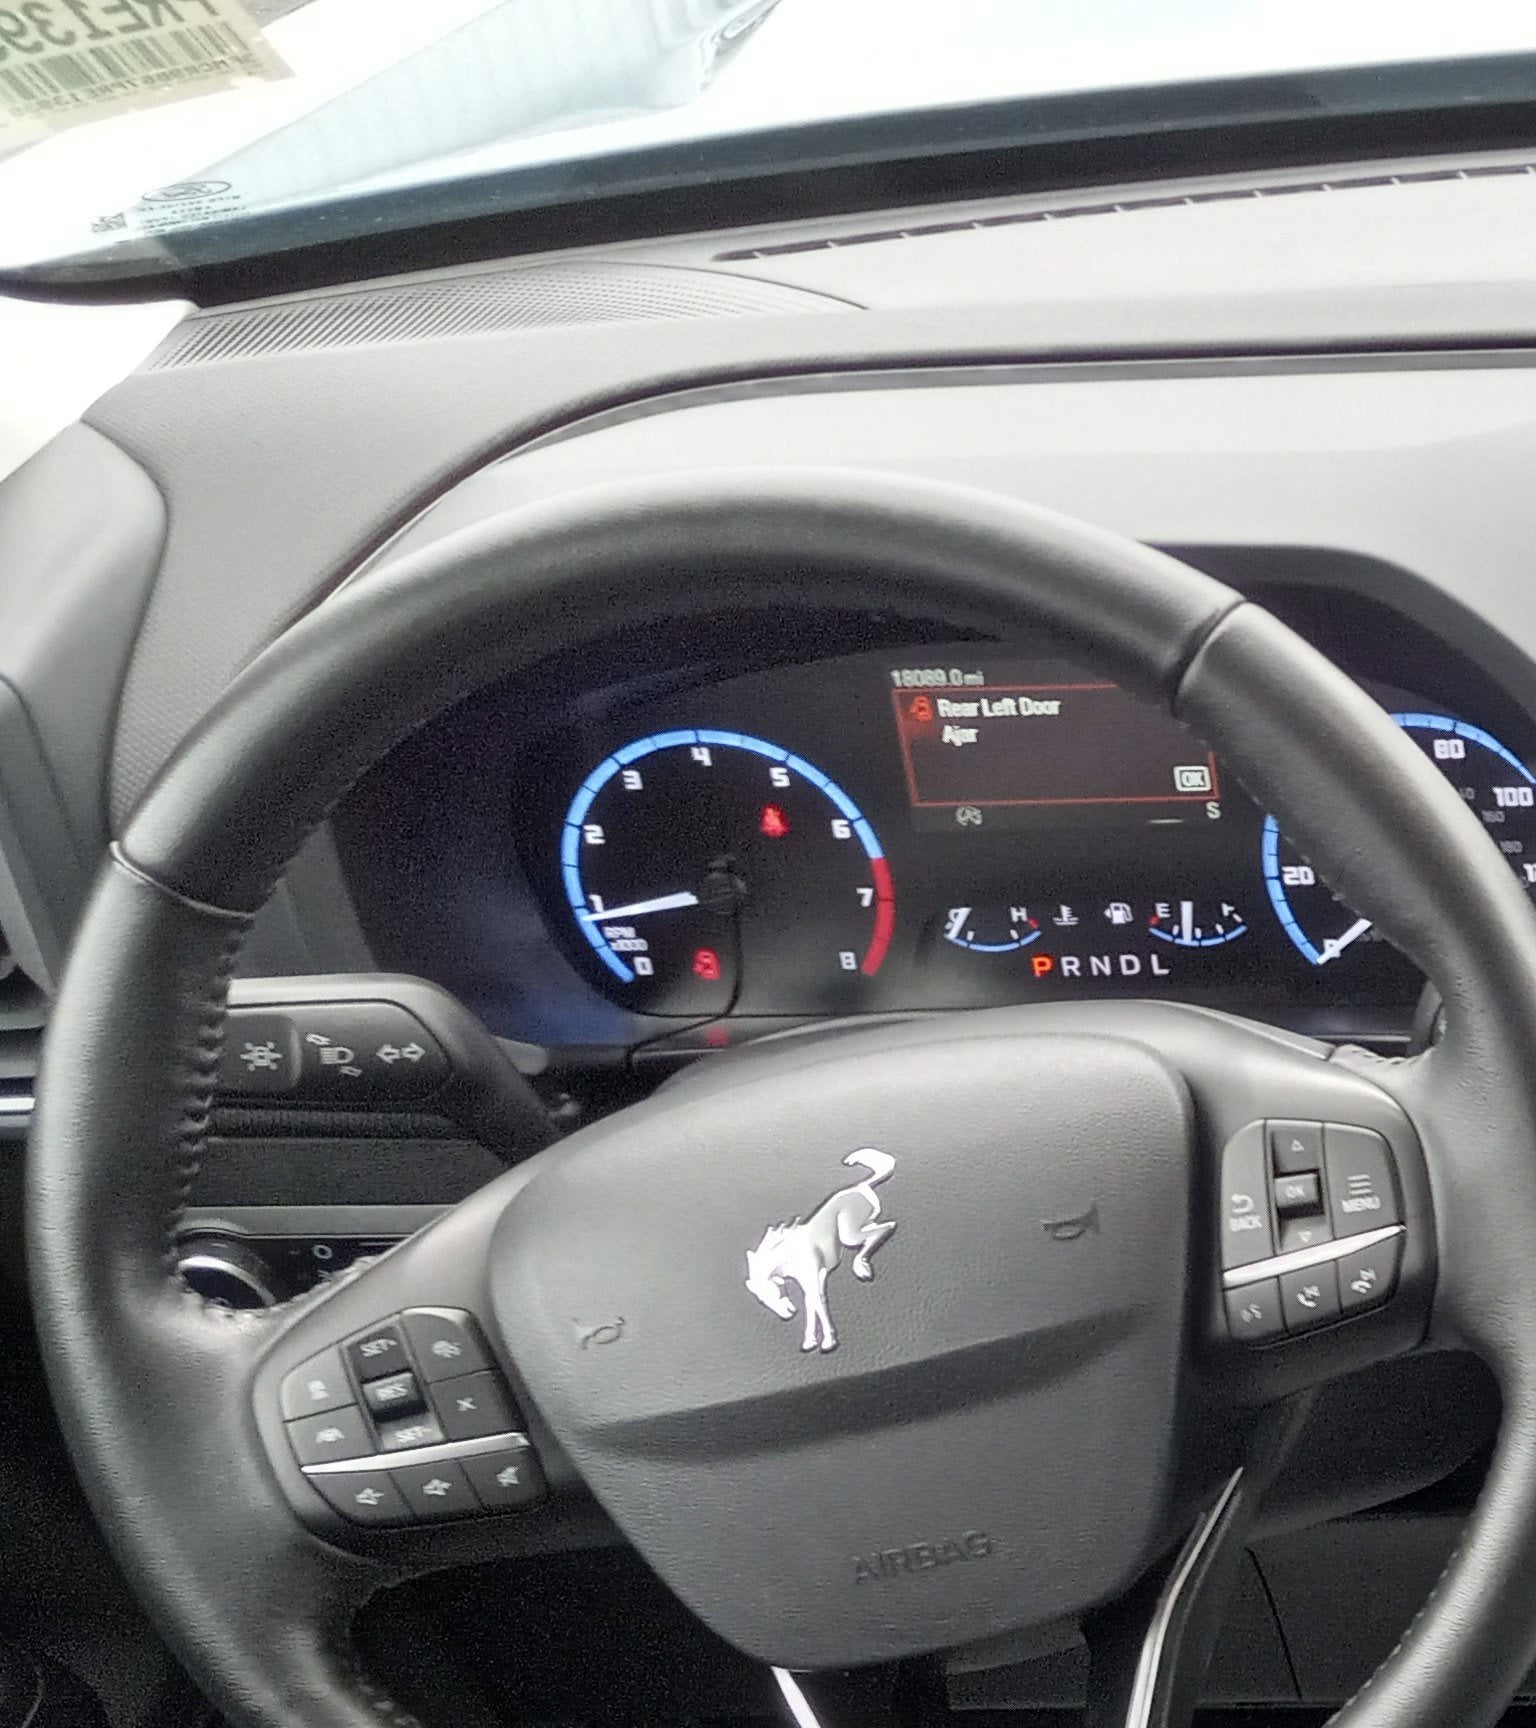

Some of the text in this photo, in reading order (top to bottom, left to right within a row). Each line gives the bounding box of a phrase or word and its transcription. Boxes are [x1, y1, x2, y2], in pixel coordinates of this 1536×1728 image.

[937, 696, 1061, 717] Rear Left Door
[942, 725, 979, 747] Ajar
[691, 747, 713, 767] 4
[1433, 739, 1465, 760] 80
[622, 770, 644, 790] 3
[769, 767, 790, 788] 5
[1492, 786, 1534, 807] 100
[1206, 802, 1221, 819] S
[583, 824, 605, 845] 2
[831, 819, 851, 840] 6
[1282, 865, 1315, 887] 20
[856, 887, 874, 907] 7
[839, 951, 858, 970] 8
[853, 1529, 994, 1586] AIRBAG
